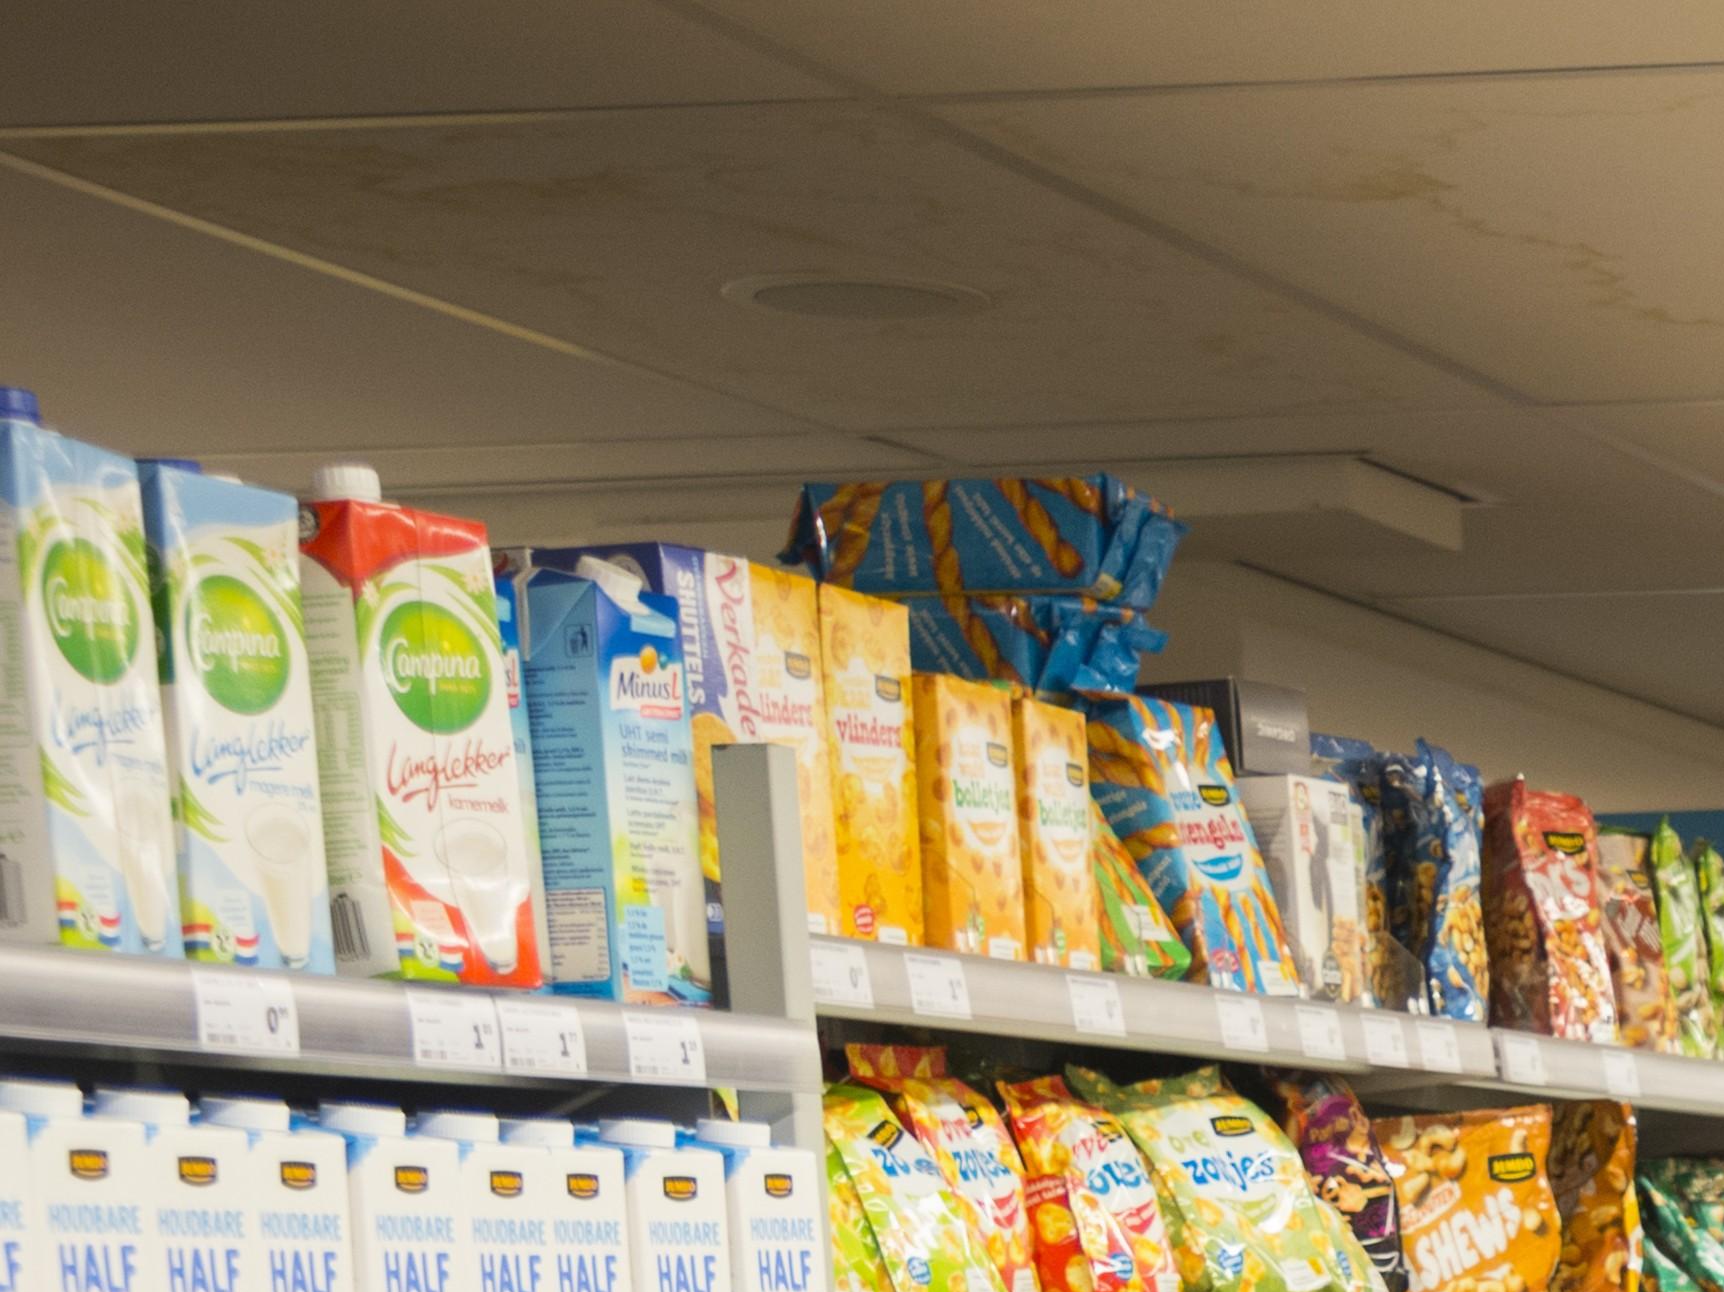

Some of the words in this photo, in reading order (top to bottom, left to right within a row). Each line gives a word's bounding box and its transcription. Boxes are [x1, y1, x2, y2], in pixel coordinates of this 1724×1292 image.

[380, 634, 484, 694] Campina
[714, 557, 756, 737] Verkade
[616, 670, 681, 706] MinusL
[836, 714, 901, 749] vlinders
[158, 1210, 245, 1241] HOUDBARE
[750, 1217, 816, 1241] HOUDBARE
[757, 1252, 811, 1291] HALF
